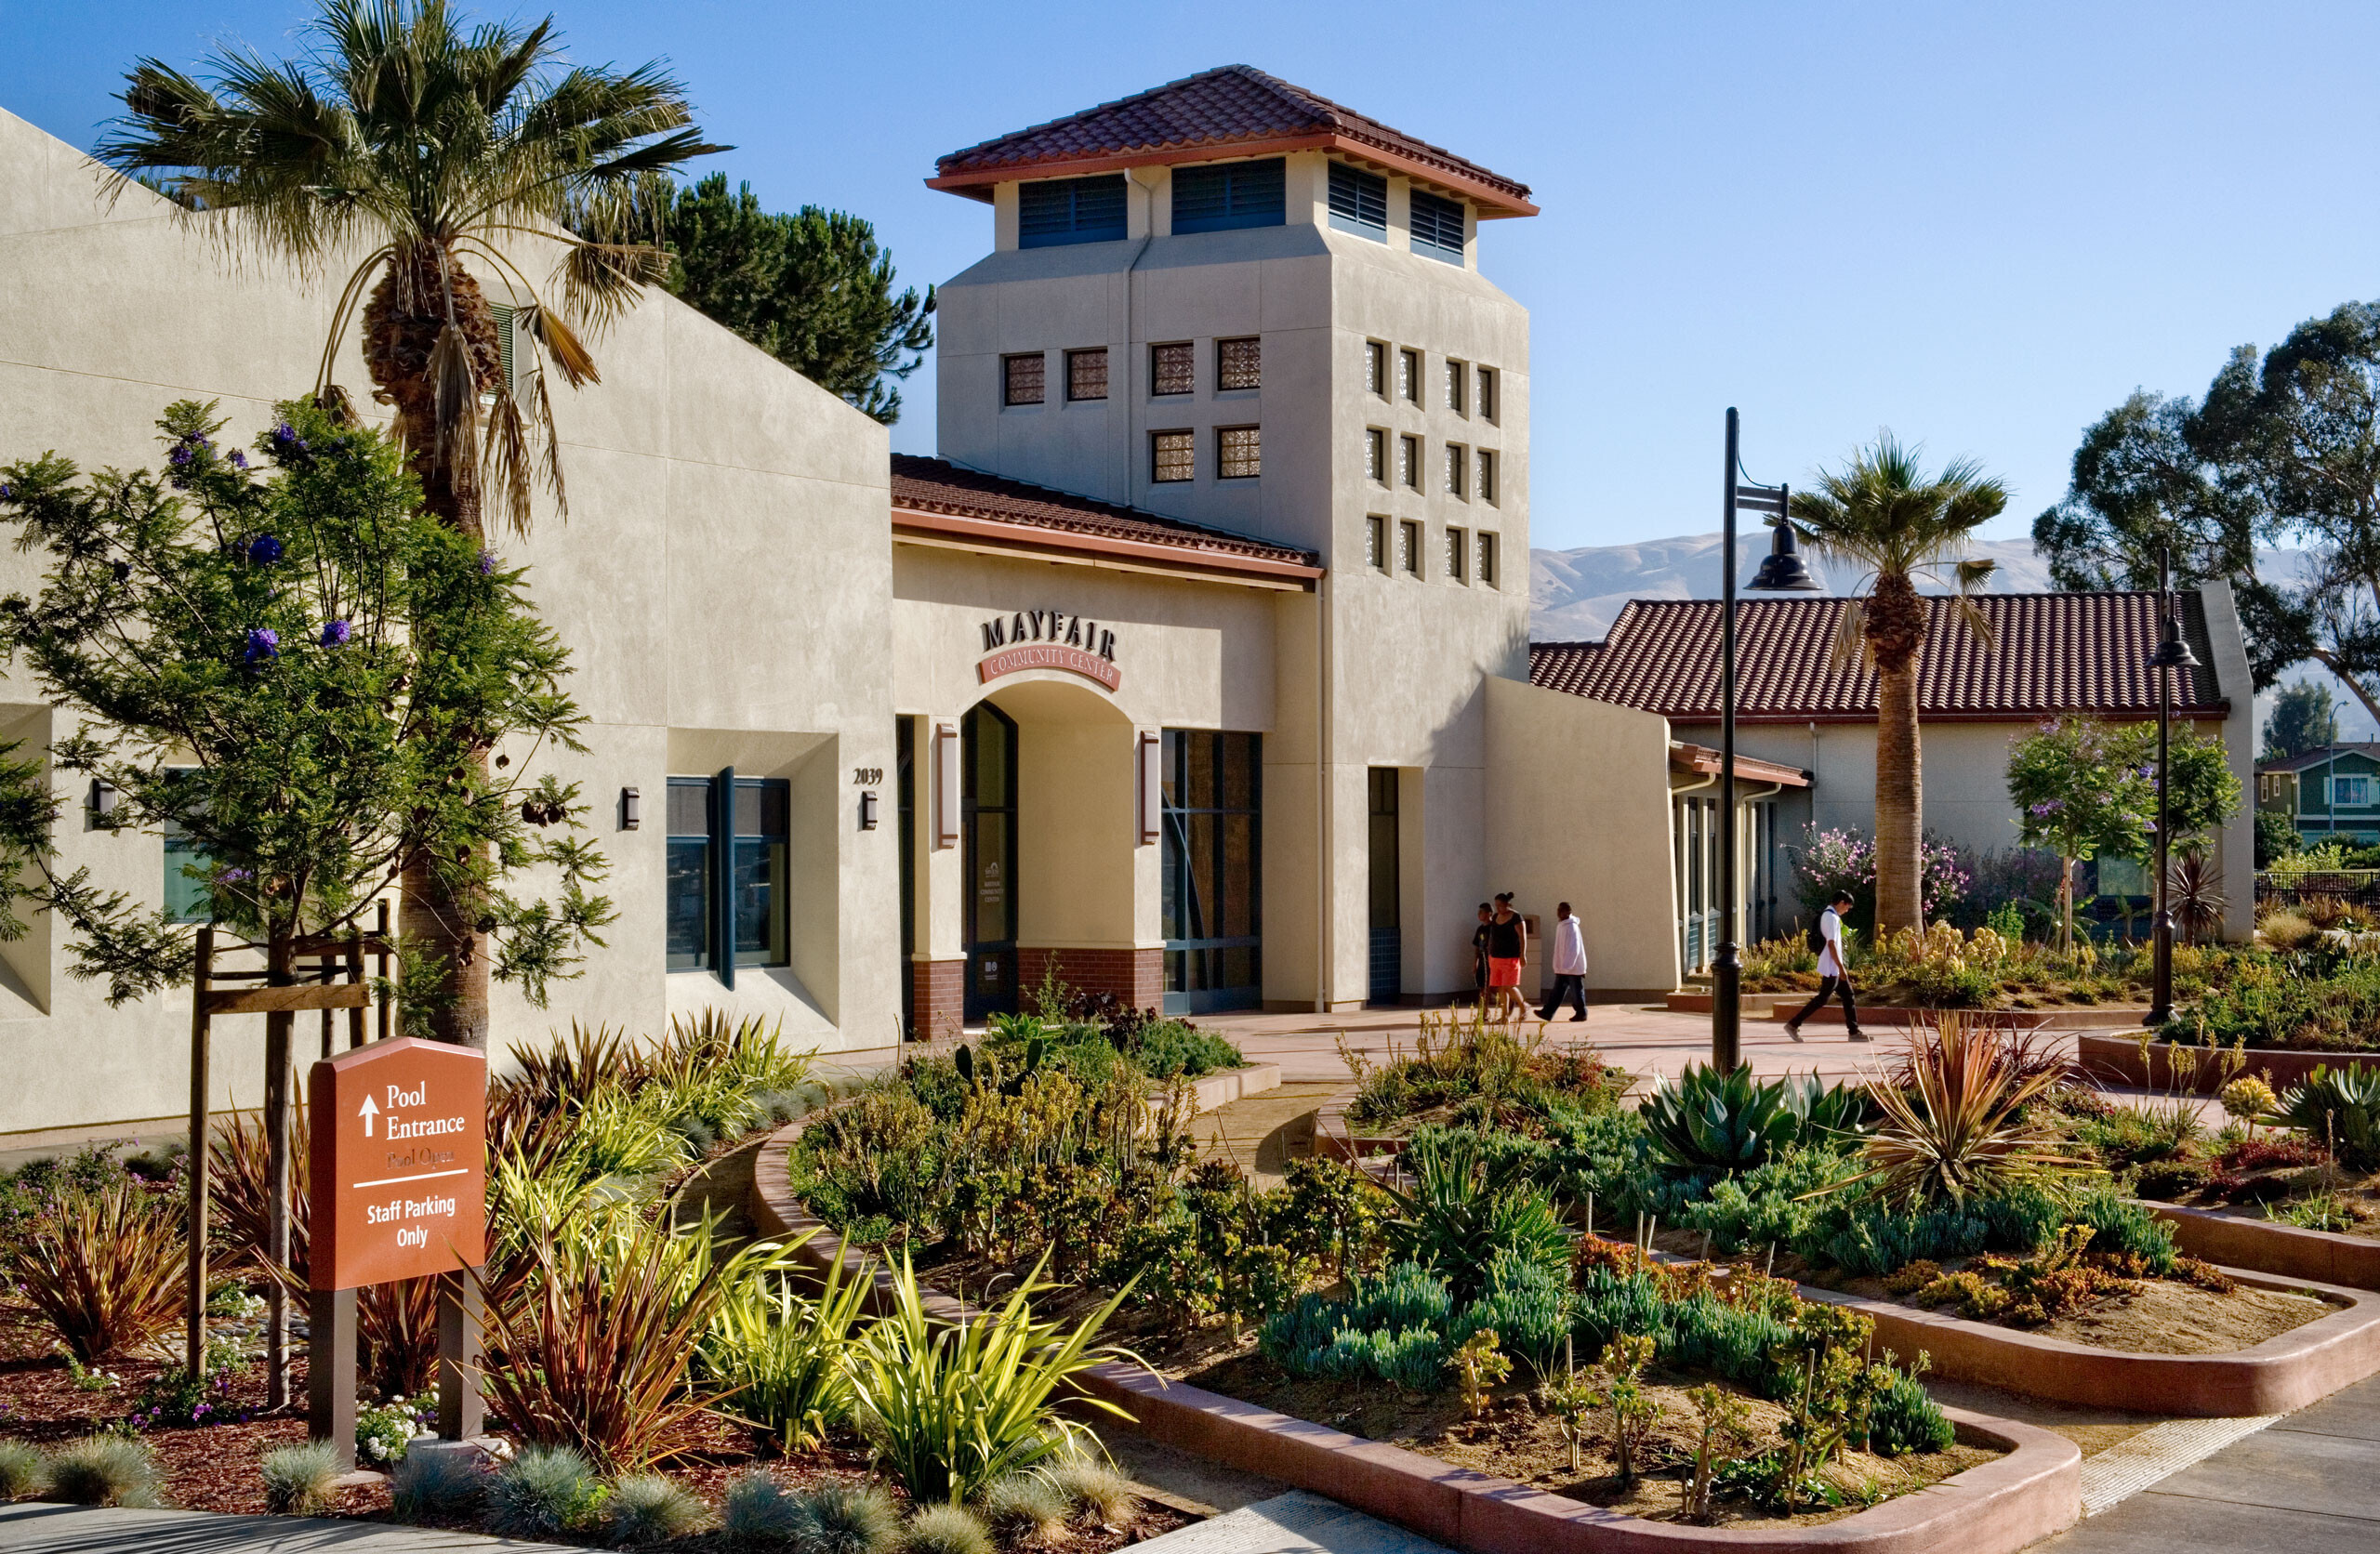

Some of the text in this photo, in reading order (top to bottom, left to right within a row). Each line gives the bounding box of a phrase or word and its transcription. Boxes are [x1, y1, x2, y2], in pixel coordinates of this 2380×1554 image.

[980, 610, 1117, 664] MAYFAIR
[990, 648, 1115, 683] COMMUNITY CENTER
[853, 767, 883, 785] 2039
[386, 1080, 427, 1109] Pool
[386, 1116, 465, 1140] Entrance
[386, 1148, 416, 1169] Pool
[367, 1195, 456, 1224] Staff Parking
[397, 1225, 429, 1248] Only
